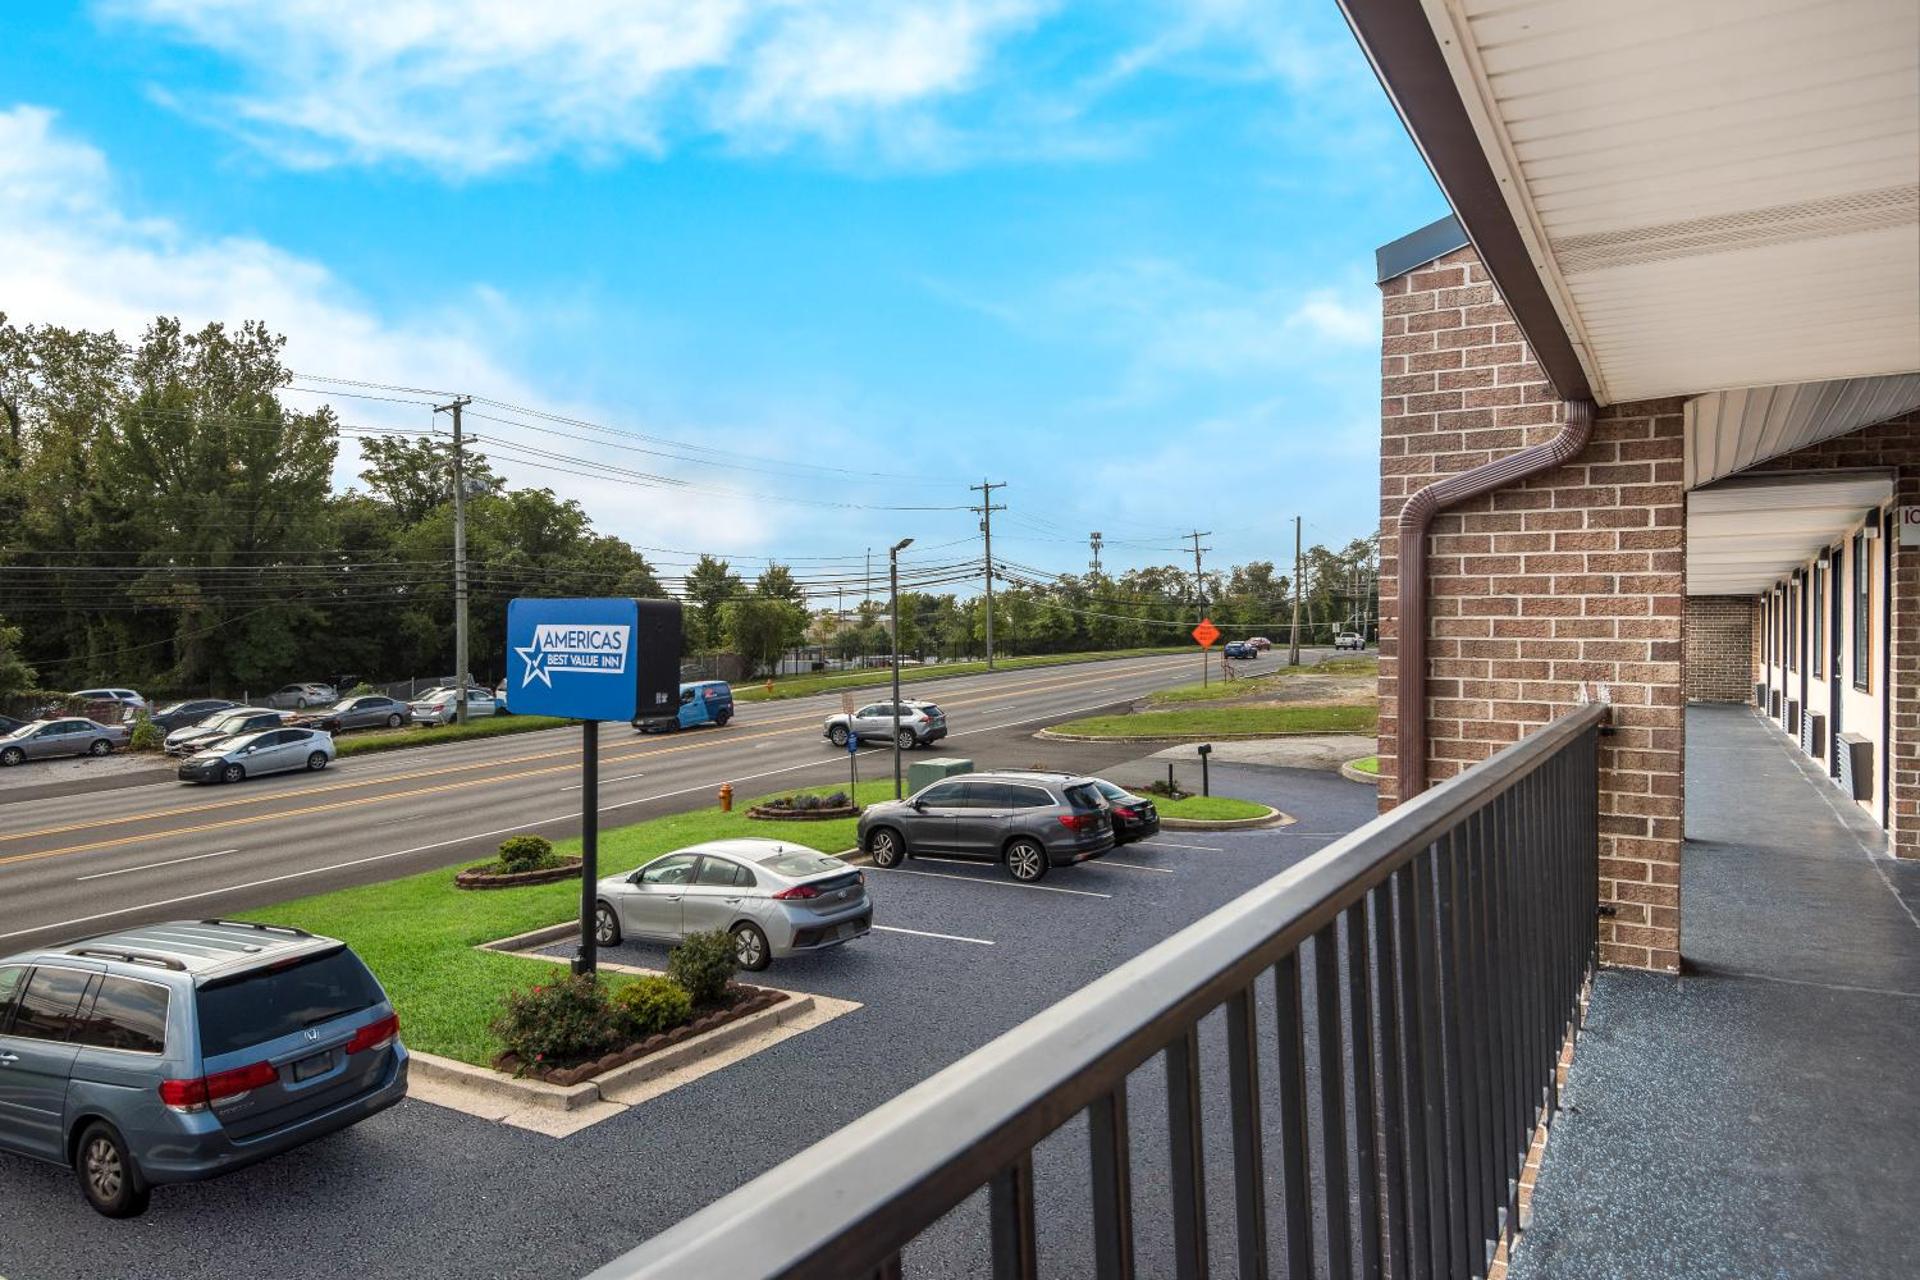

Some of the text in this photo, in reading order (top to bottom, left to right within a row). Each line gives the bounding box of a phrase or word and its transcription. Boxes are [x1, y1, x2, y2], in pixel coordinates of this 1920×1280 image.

[543, 630, 622, 649] AMERICAS
[547, 654, 620, 667] BEST VALUE INN
